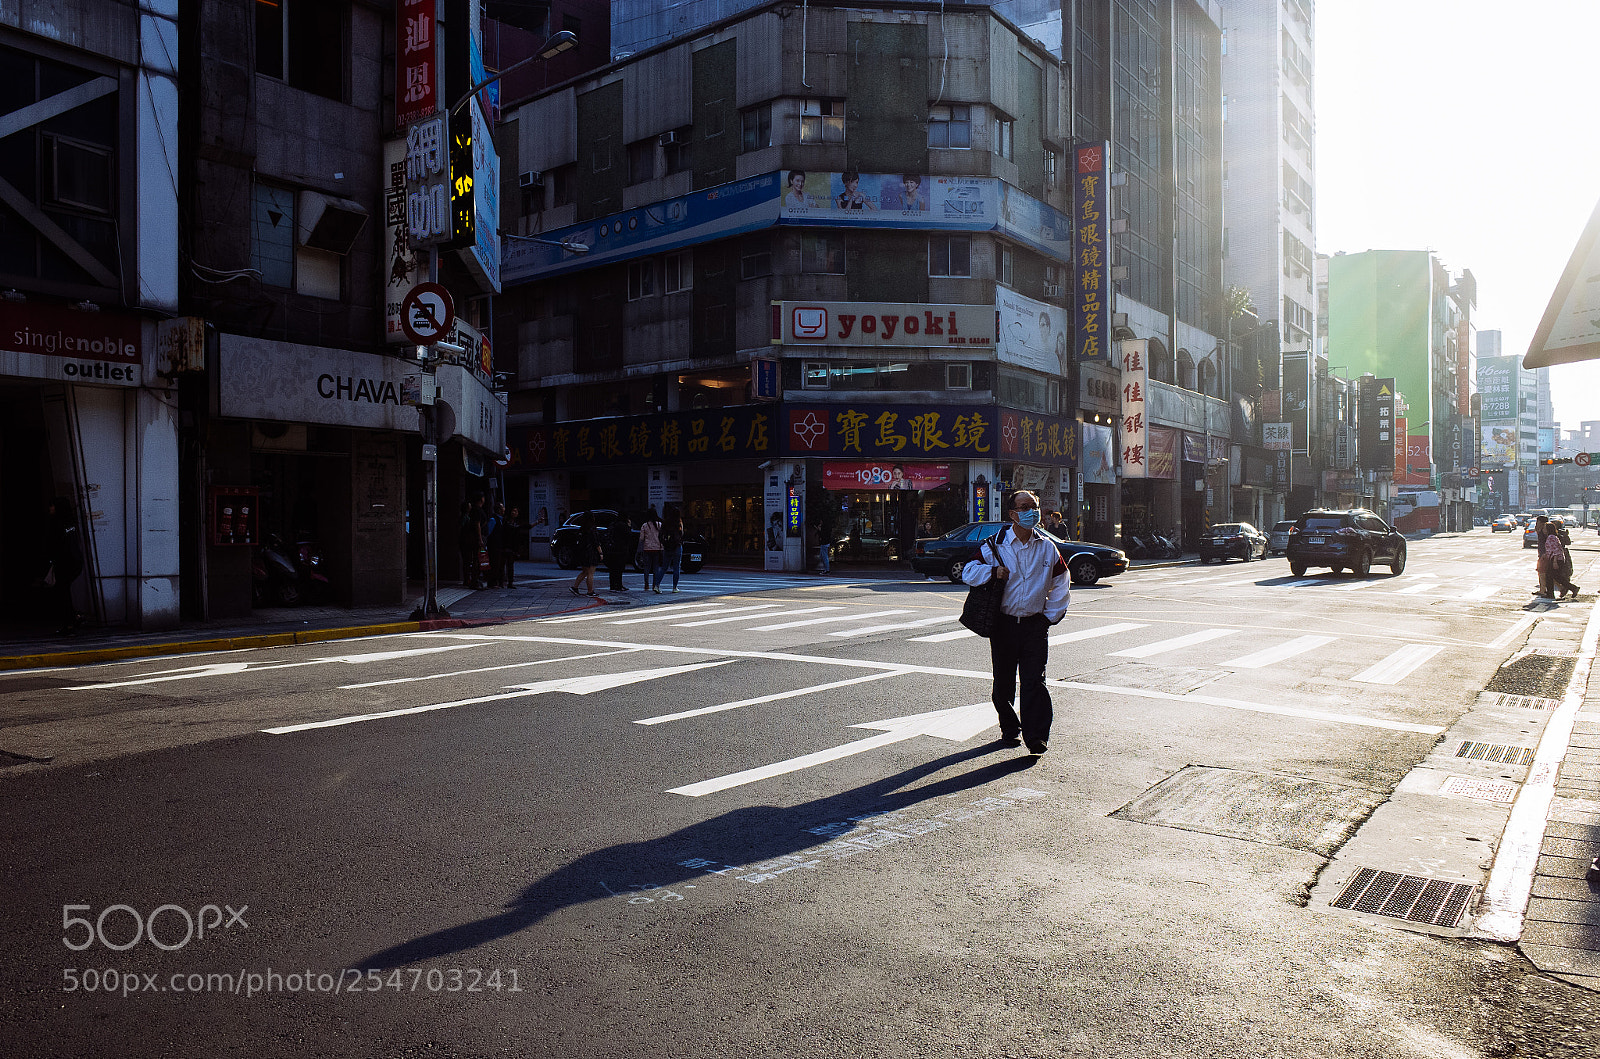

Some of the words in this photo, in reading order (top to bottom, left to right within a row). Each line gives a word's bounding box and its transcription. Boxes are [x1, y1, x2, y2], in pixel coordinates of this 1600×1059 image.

[406, 118, 446, 241] 網咖
[1080, 174, 1103, 357] 寶島眼鏡精品名店
[14, 326, 136, 357] singlenoble
[838, 310, 958, 339] yoyoki
[64, 362, 134, 382] outlet
[836, 409, 990, 453] 寶島眼鏡
[1123, 352, 1144, 466] 佳佳銀樓
[1379, 406, 1390, 441] 拓荒者
[552, 412, 769, 464] 寶島眼鏡精品名店
[1020, 415, 1077, 461] 寶島眼鏡
[1452, 423, 1461, 468] AIGLE
[855, 466, 892, 485] 1980
[790, 497, 800, 532] 精品名店
